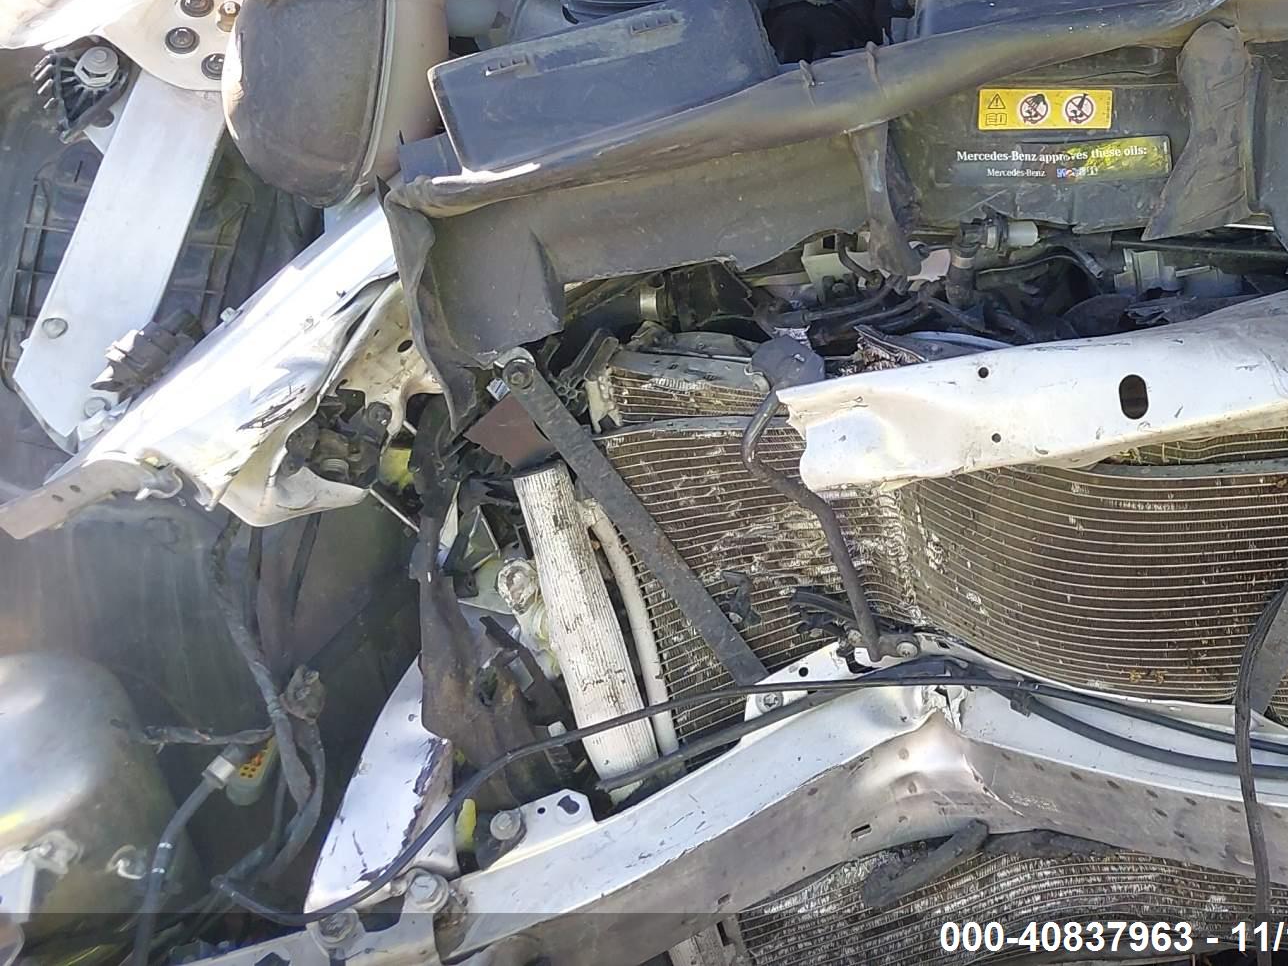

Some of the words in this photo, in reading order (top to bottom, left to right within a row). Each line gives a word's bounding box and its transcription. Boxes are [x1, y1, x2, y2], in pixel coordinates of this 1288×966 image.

[956, 150, 1038, 162] Mercedes-Benz
[1039, 151, 1088, 164] approves
[1091, 146, 1122, 158] these
[1123, 145, 1148, 156] oils:
[987, 168, 1046, 177] Mercedes-Benz
